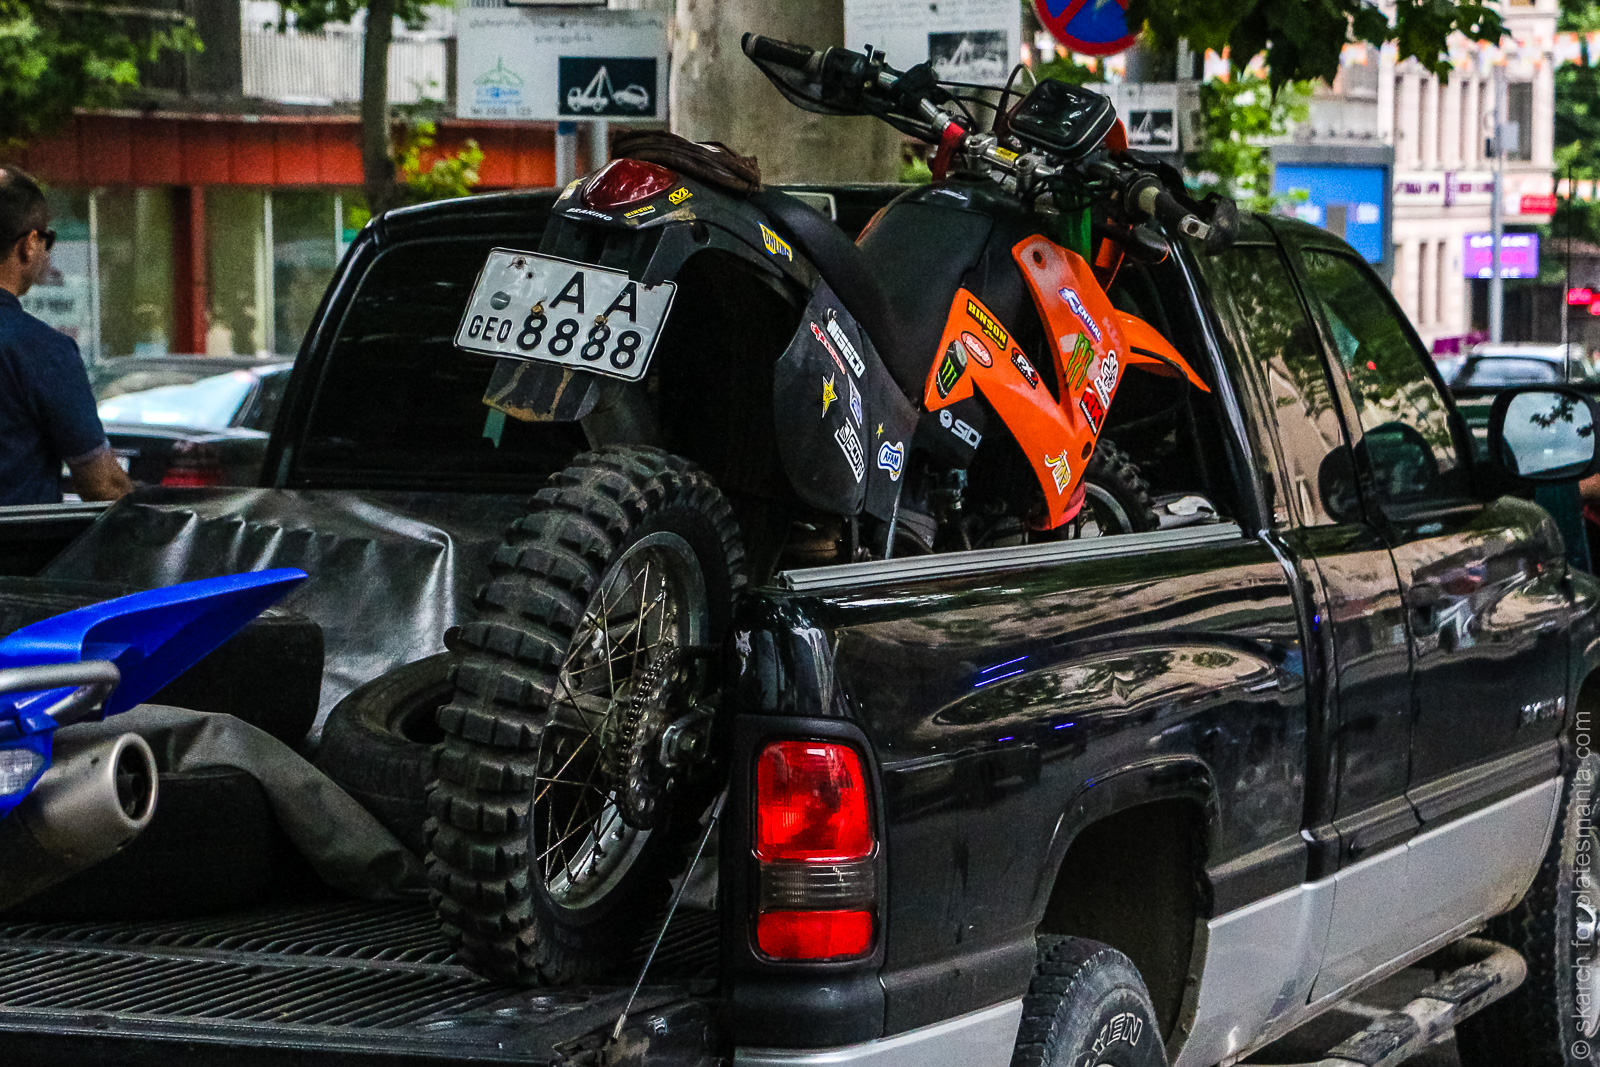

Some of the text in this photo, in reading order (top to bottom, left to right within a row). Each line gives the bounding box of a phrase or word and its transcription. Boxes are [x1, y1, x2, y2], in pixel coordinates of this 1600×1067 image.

[968, 301, 1007, 344] HINSON
[1059, 287, 1101, 342] RENTHAL
[468, 314, 642, 370] GEO 8888
[1083, 391, 1103, 428] RK
[883, 451, 899, 467] AFAM
